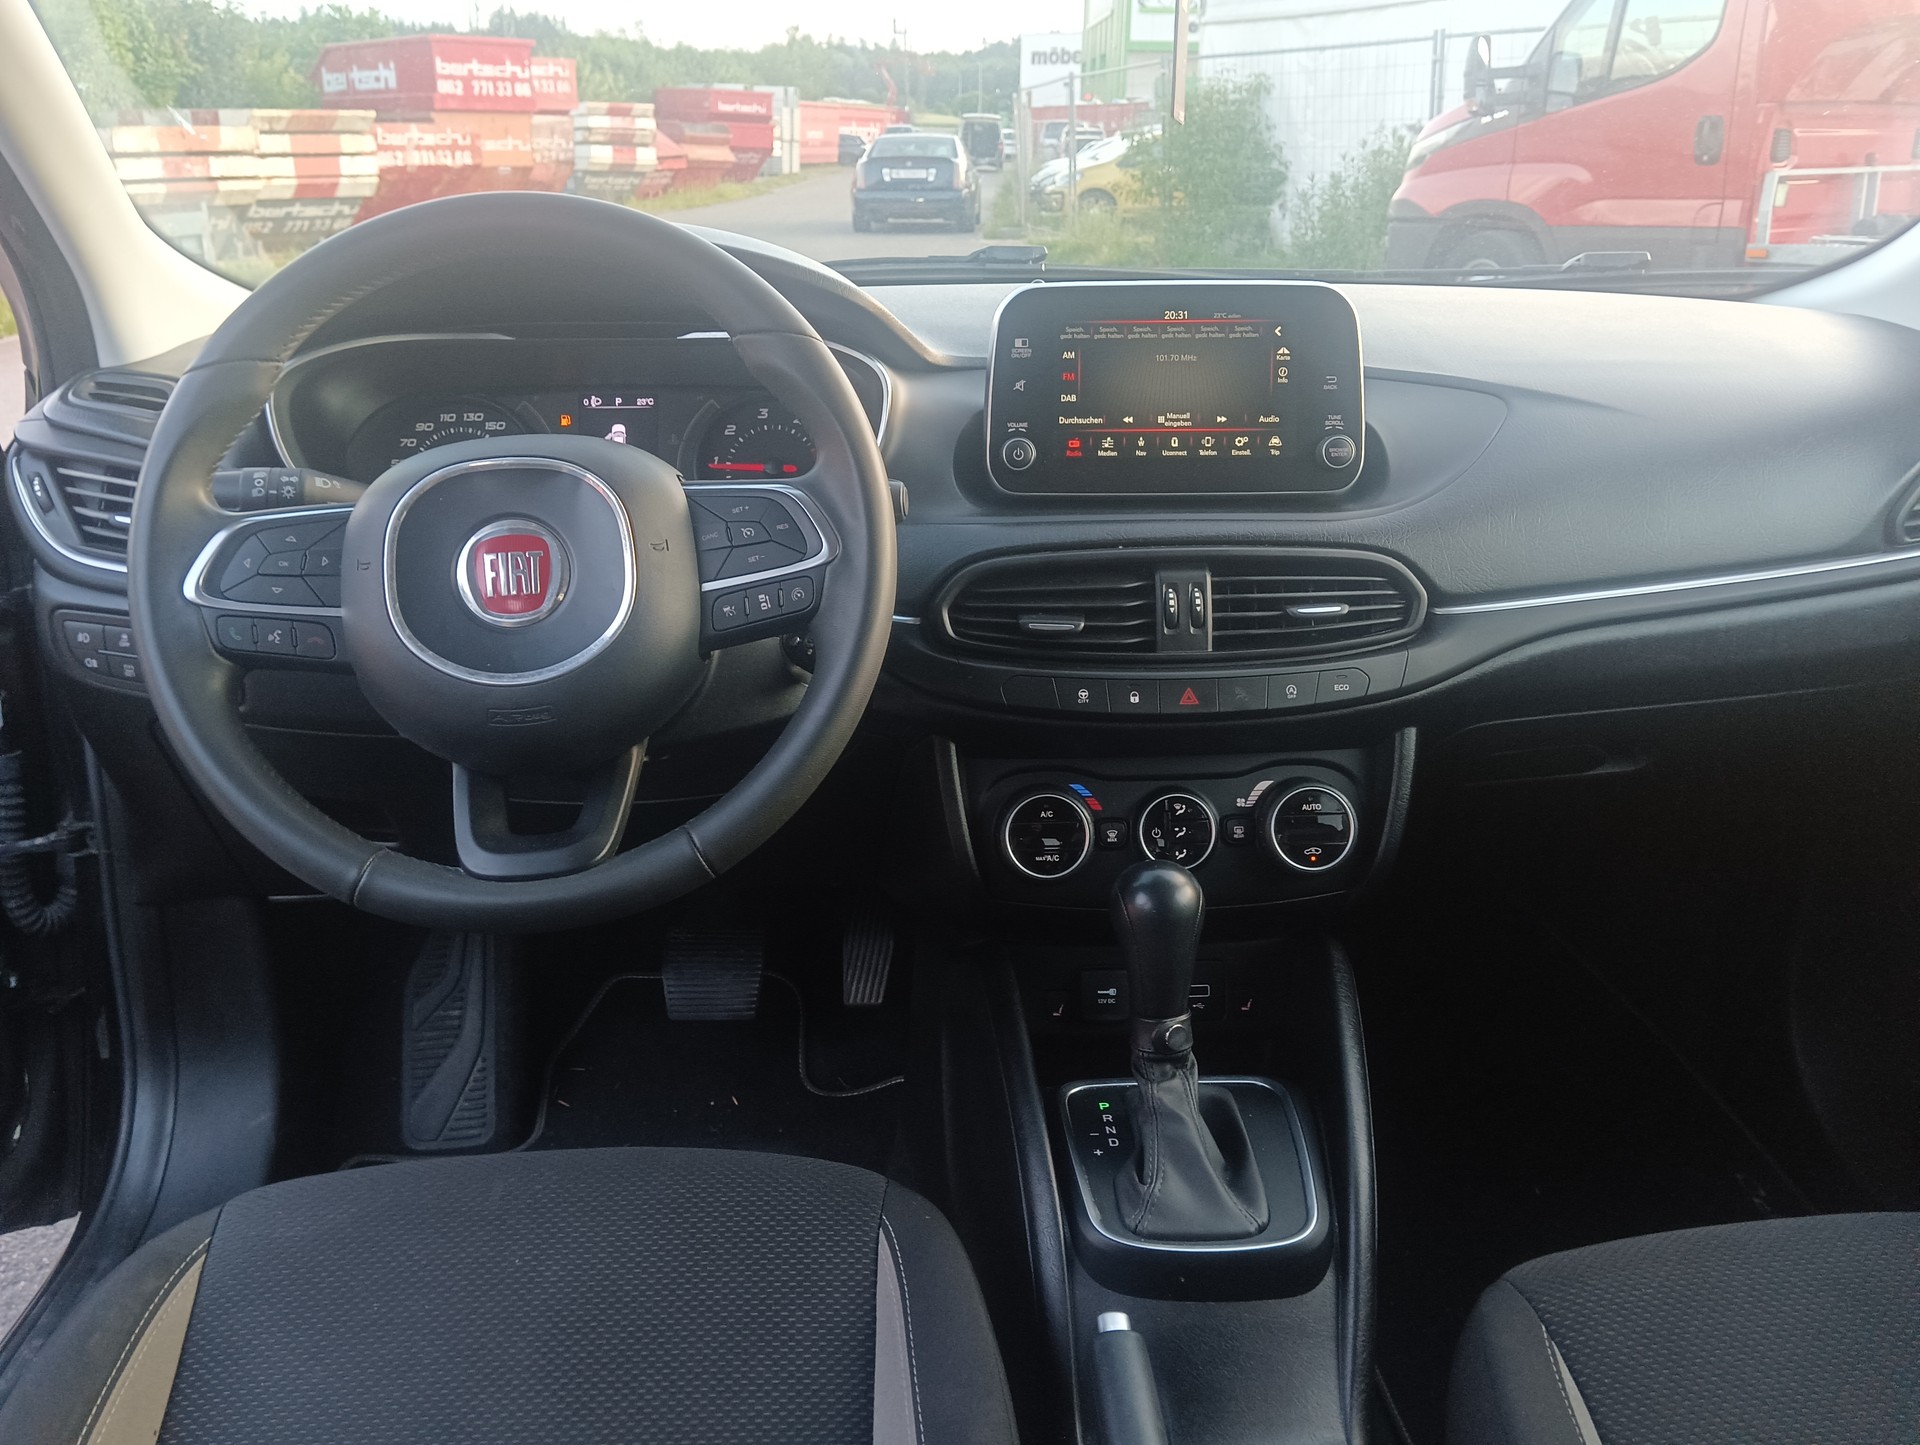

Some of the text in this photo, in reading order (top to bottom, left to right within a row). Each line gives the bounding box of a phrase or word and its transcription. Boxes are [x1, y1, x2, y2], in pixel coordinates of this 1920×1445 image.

[1164, 310, 1188, 320] 20:31
[1062, 351, 1075, 359] AM
[1156, 354, 1197, 362] 101.70 MHz
[1062, 372, 1075, 381] FM
[1060, 394, 1077, 402] DAB
[439, 413, 456, 422] 110
[463, 412, 484, 421] 130
[757, 408, 769, 419] 3
[1166, 412, 1191, 420] Manuell
[1058, 416, 1103, 425] Durchsuchen
[1258, 415, 1280, 423] Audio
[415, 422, 434, 431] 90
[485, 421, 506, 430] 150
[1164, 420, 1192, 428] eingeben
[724, 424, 737, 435] 2
[400, 438, 417, 447] 70
[731, 506, 743, 514] SET
[747, 555, 760, 563] SET
[483, 551, 544, 598] FIAT
[1334, 683, 1350, 692] ECO
[1302, 803, 1321, 811] AUTO
[1040, 810, 1054, 818] A/C
[1099, 1102, 1110, 1110] P
[1102, 1114, 1113, 1122] R
[1105, 1126, 1117, 1134] N
[1108, 1138, 1119, 1147] D
